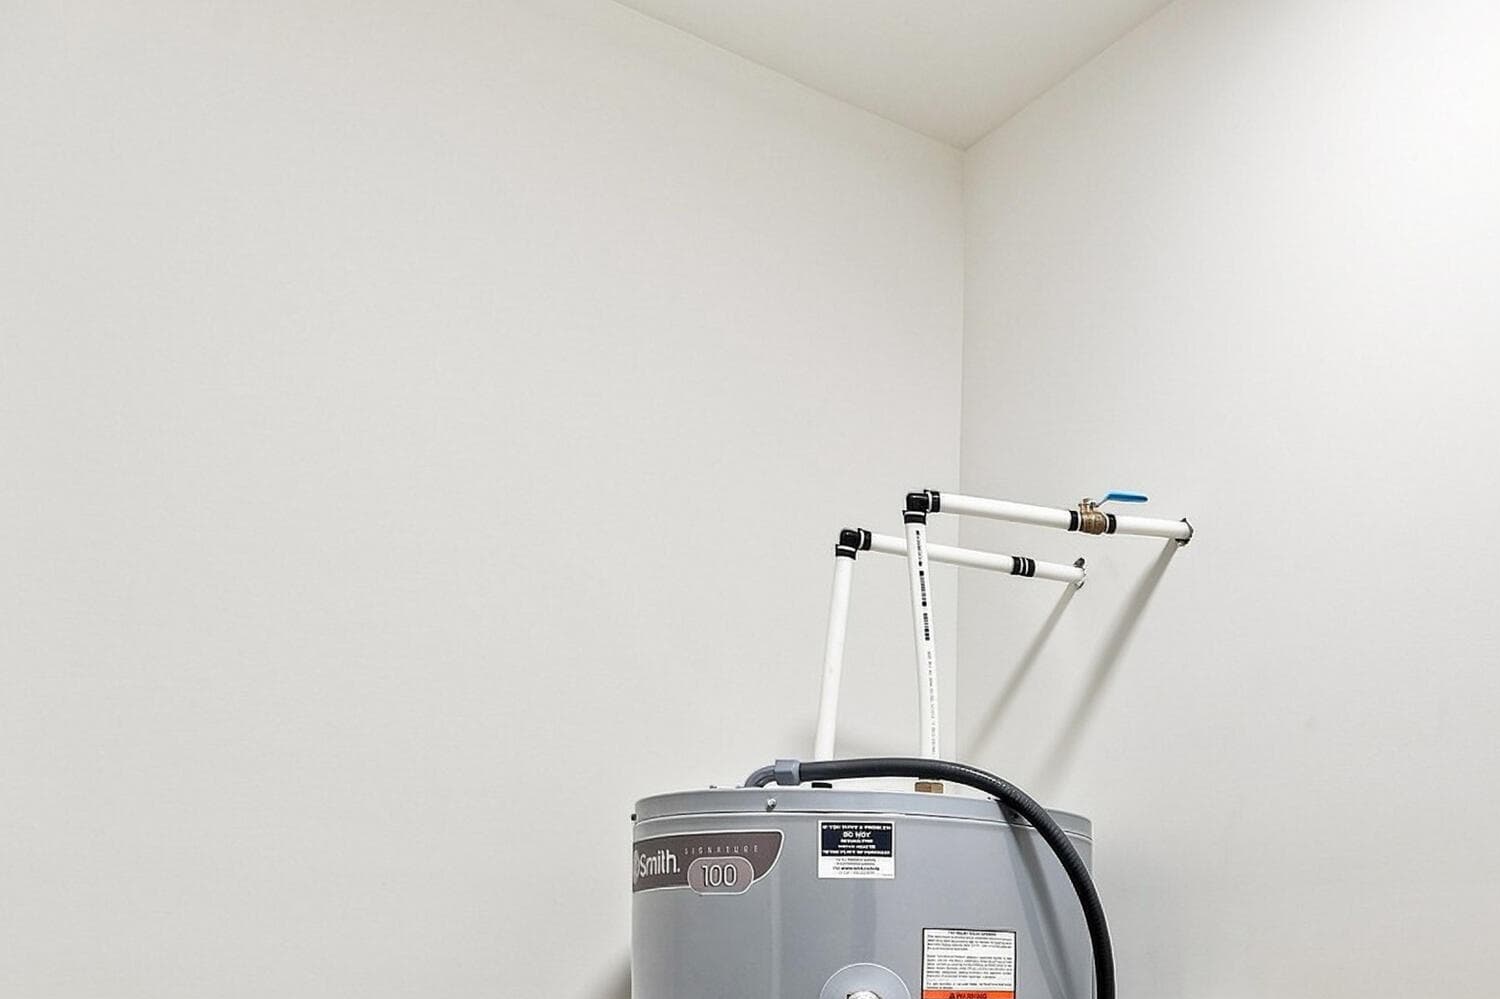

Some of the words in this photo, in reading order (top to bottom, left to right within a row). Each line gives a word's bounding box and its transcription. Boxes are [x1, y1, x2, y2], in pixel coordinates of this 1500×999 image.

[684, 844, 759, 855] SIGNATURE
[702, 864, 737, 887] 100
[956, 992, 987, 999] WARNING
